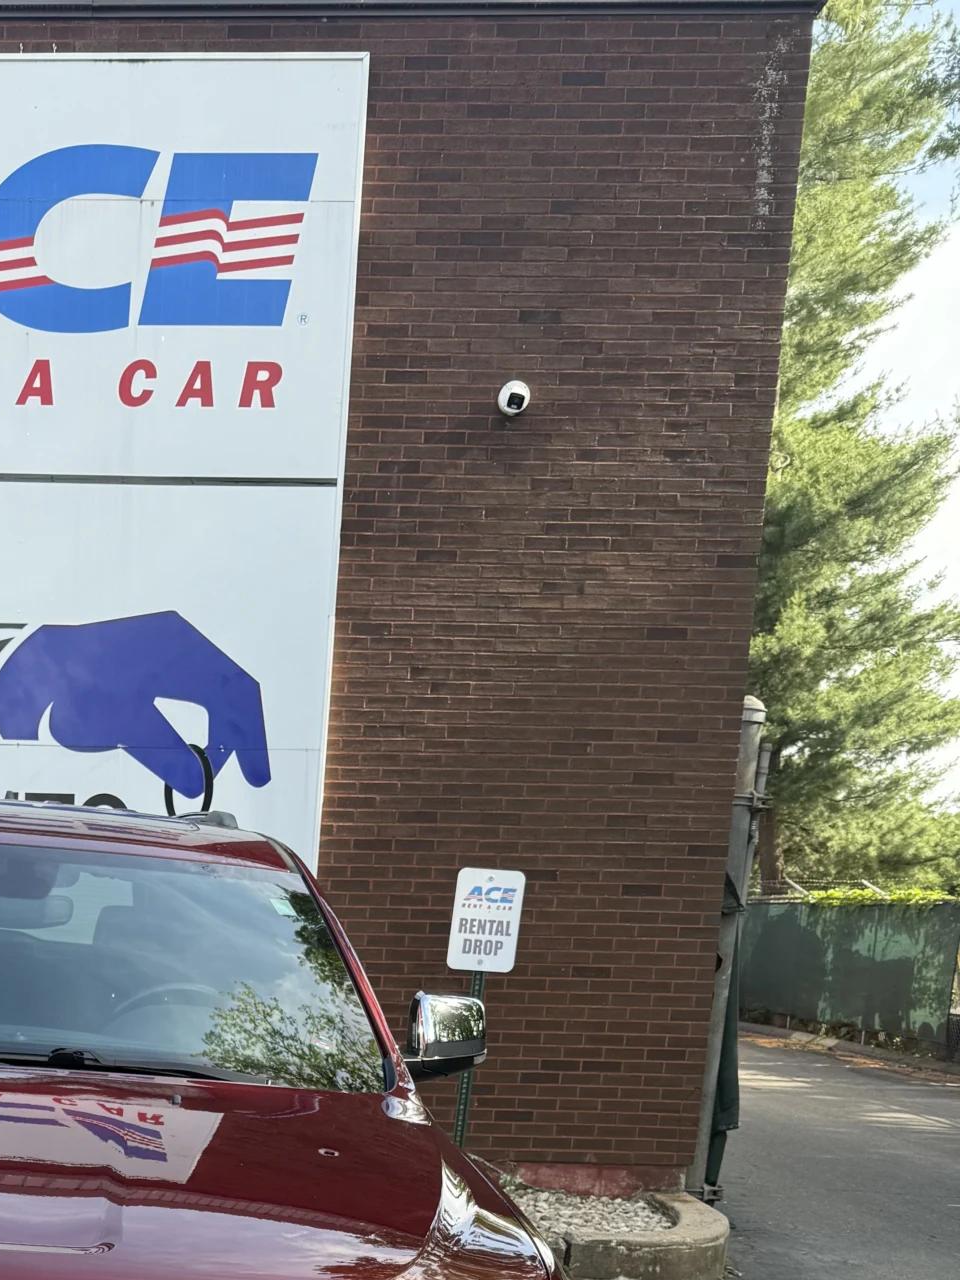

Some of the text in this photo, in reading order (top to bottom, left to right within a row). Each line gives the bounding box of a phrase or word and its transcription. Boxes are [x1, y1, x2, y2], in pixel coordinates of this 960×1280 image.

[15, 359, 54, 406] A
[118, 360, 283, 409] CAR
[463, 886, 518, 904] ACE
[458, 918, 512, 937] RENTAL
[462, 938, 503, 956] DROP
